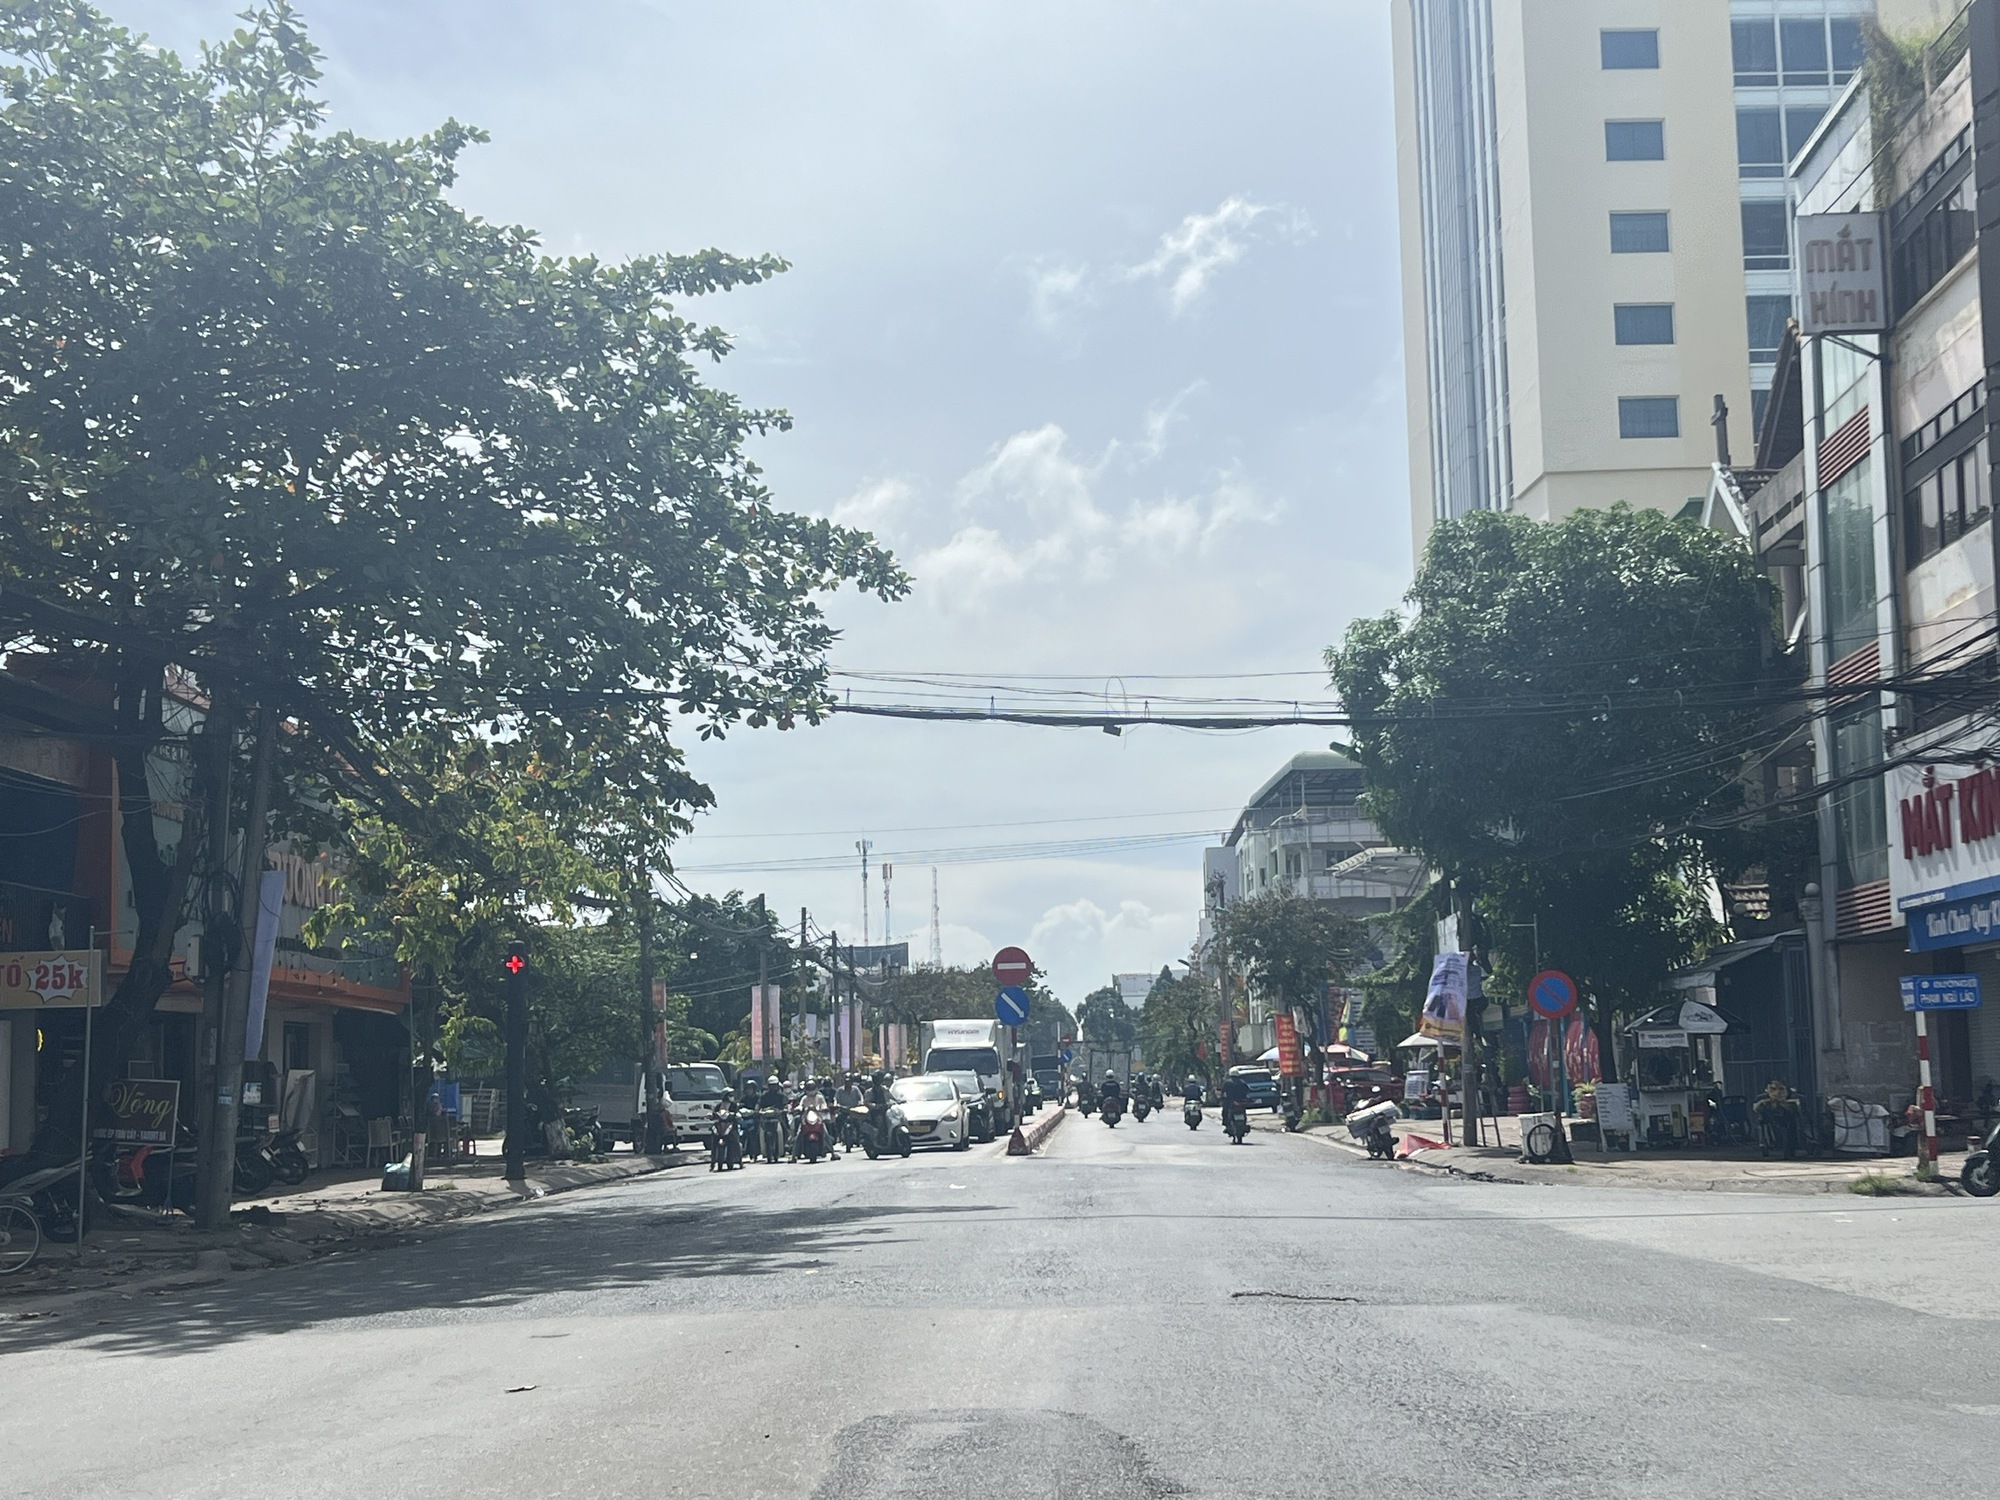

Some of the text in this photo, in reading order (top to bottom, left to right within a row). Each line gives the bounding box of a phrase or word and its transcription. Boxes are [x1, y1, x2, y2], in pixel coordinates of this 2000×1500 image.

[1805, 224, 1874, 273] MẮT
[1809, 281, 1877, 325] KÍNH
[1901, 765, 1953, 860] MẮT
[35, 964, 84, 990] 25k
[948, 1028, 980, 1036] HYUNDAI
[109, 1081, 174, 1129] Võng
